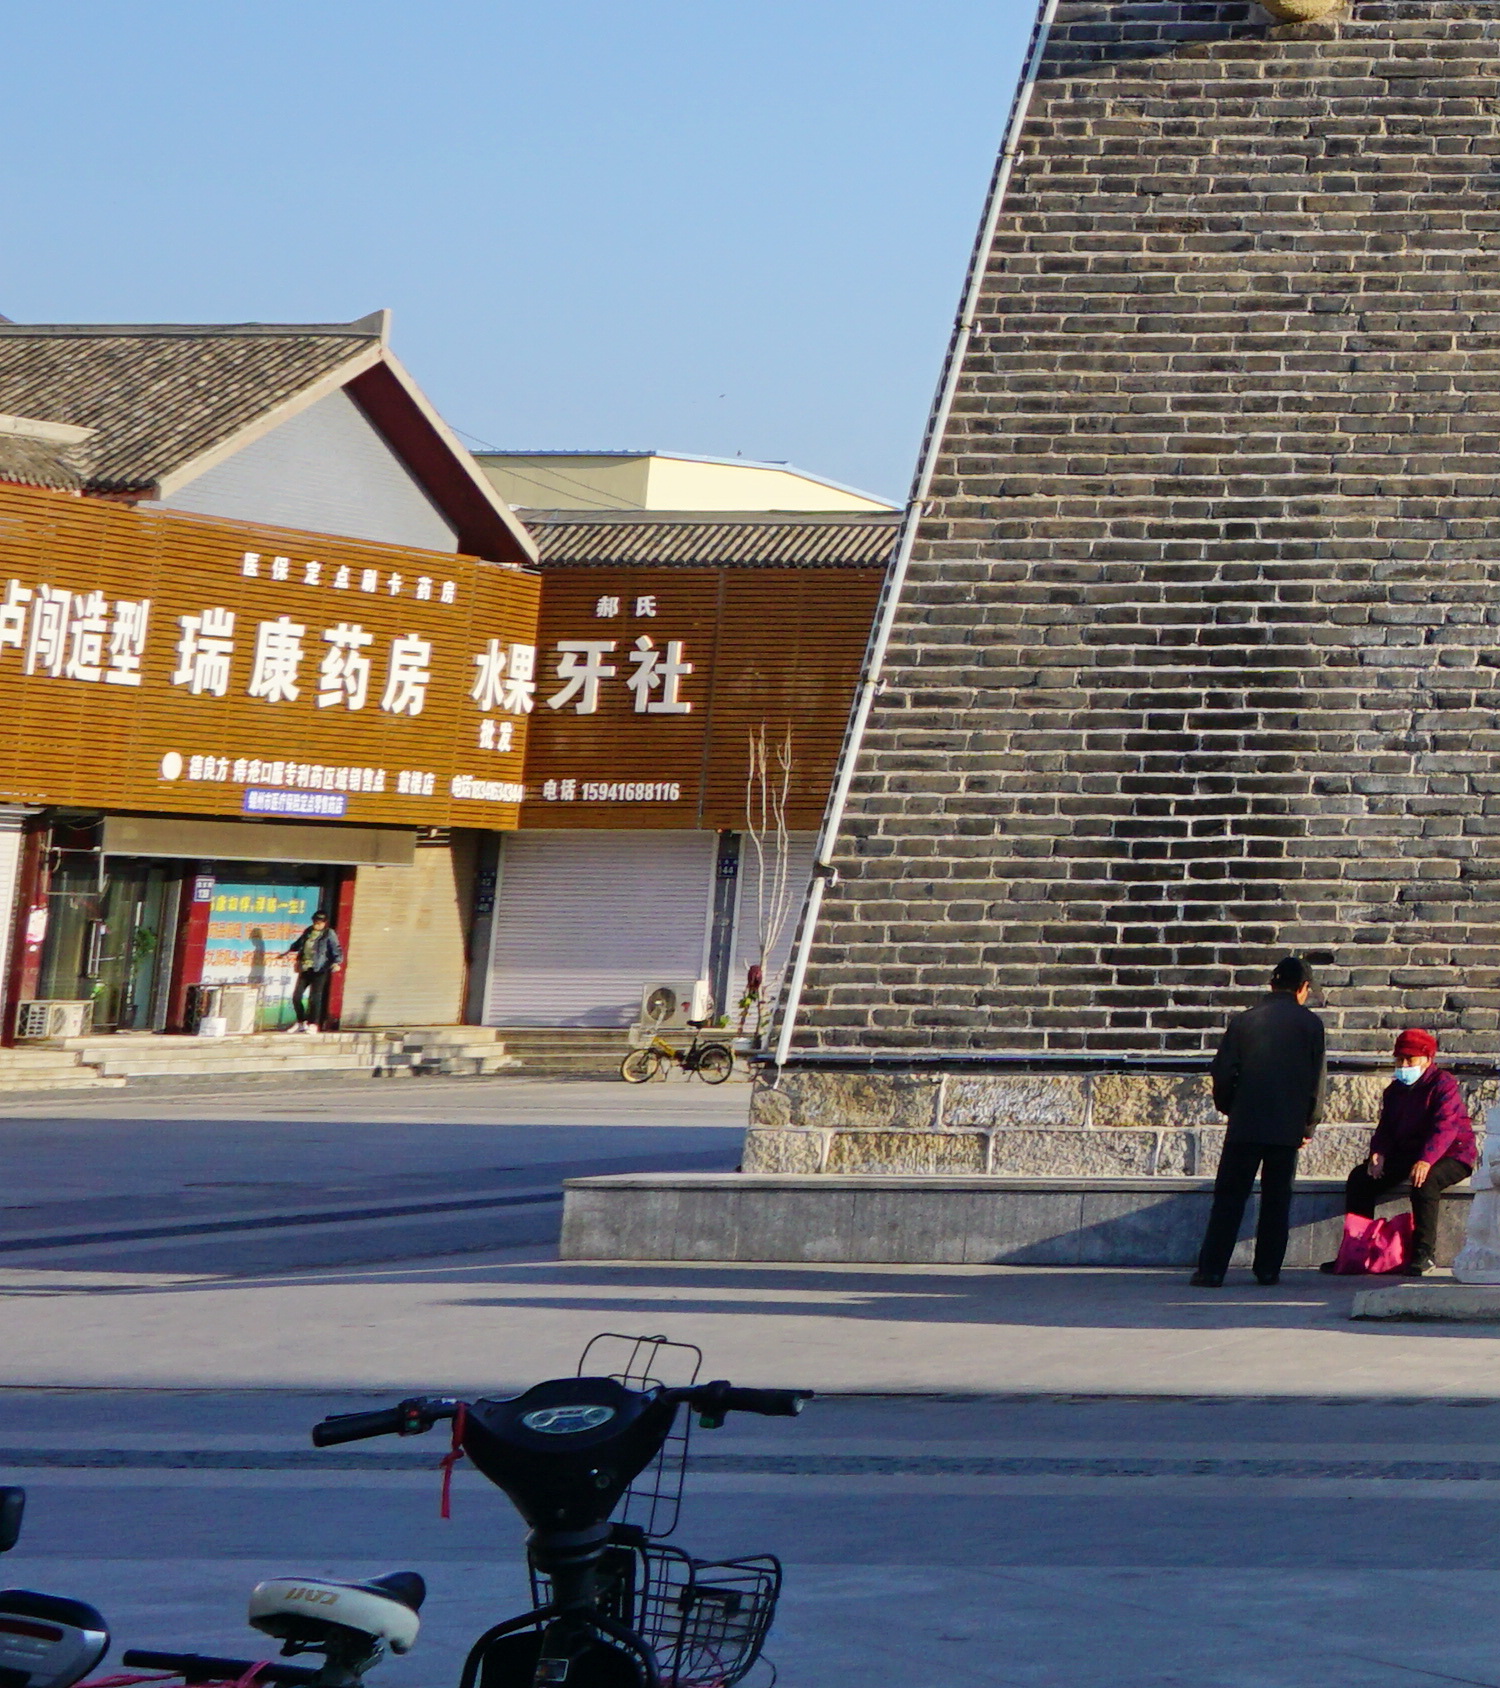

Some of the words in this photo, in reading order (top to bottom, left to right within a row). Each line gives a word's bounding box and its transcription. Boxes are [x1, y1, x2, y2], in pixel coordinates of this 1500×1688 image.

[242, 552, 457, 605] 医保定点刷卡药房
[171, 607, 433, 716] 瑞康药房
[472, 636, 538, 715] 水果
[546, 635, 694, 715] 牙社
[542, 778, 577, 801] 电话
[581, 782, 681, 802] 15941688116
